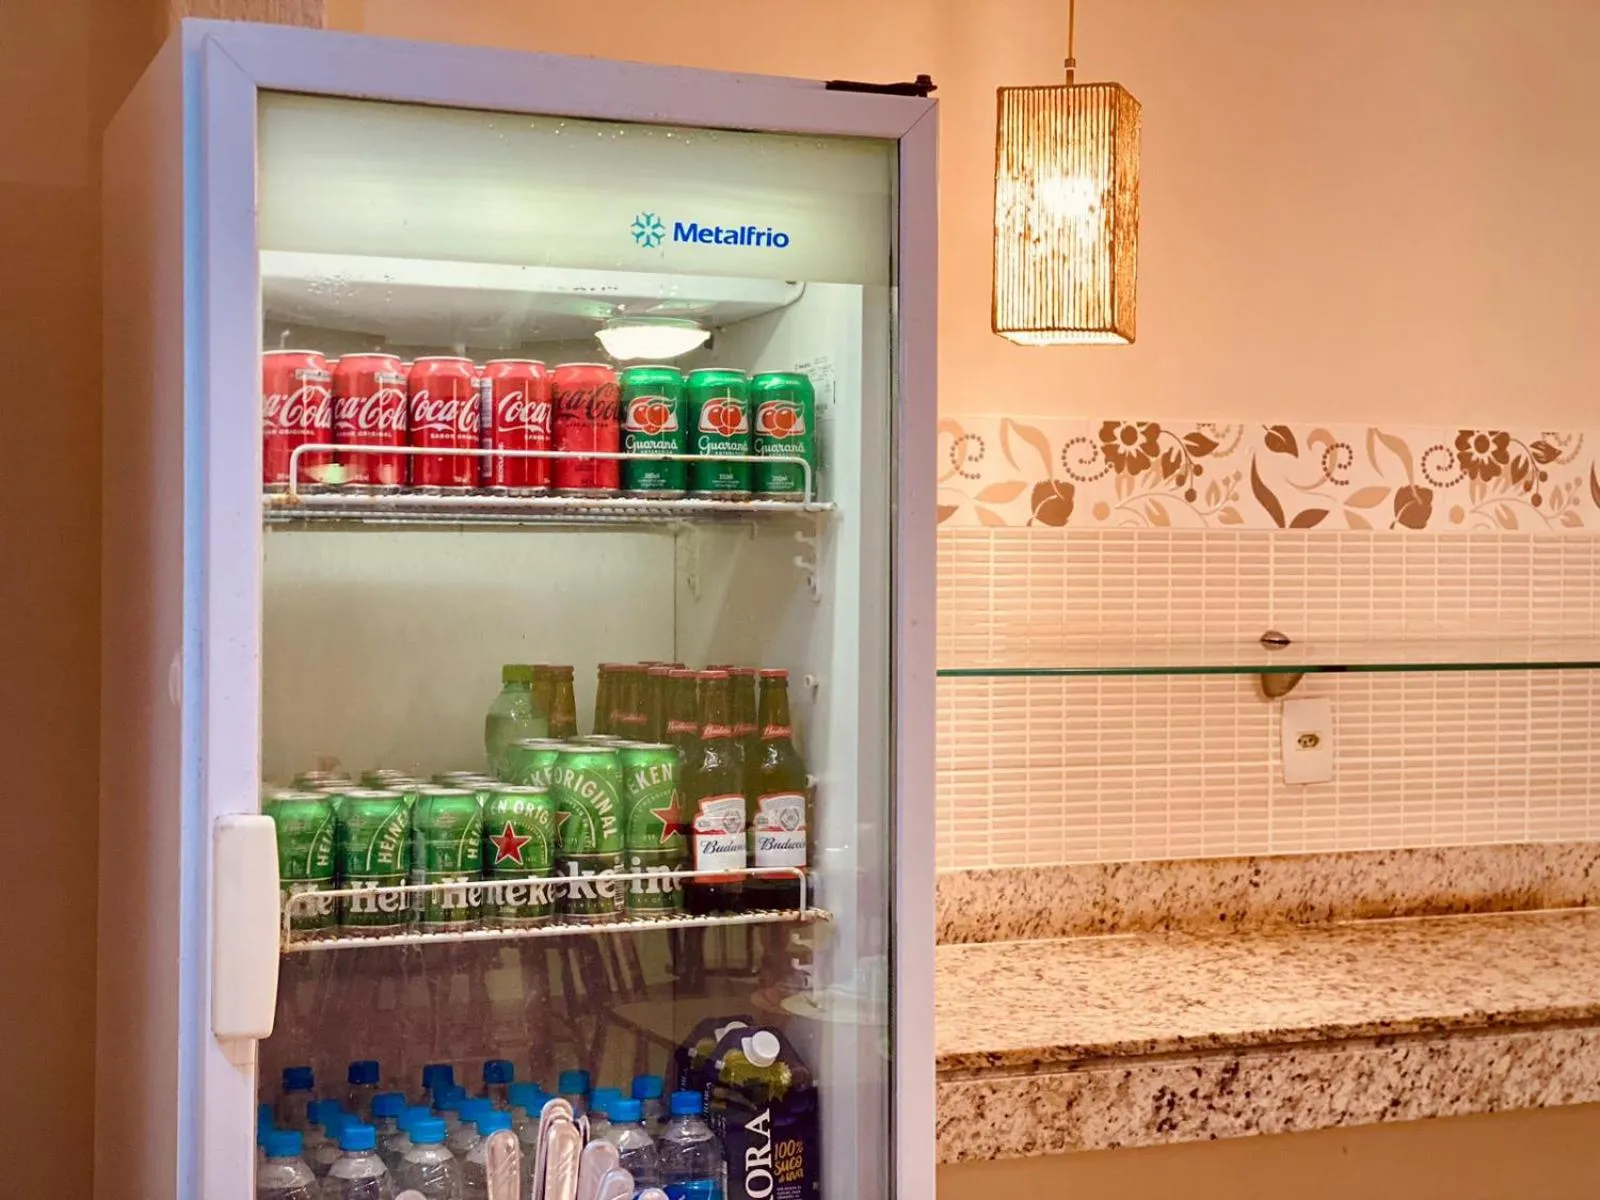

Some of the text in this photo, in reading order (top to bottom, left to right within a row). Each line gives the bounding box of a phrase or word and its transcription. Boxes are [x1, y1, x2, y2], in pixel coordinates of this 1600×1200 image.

[673, 222, 790, 248] Metalfrio
[553, 767, 618, 840] ORIGINAL
[744, 1108, 774, 1199] ORA
[774, 1139, 804, 1161] 100%
